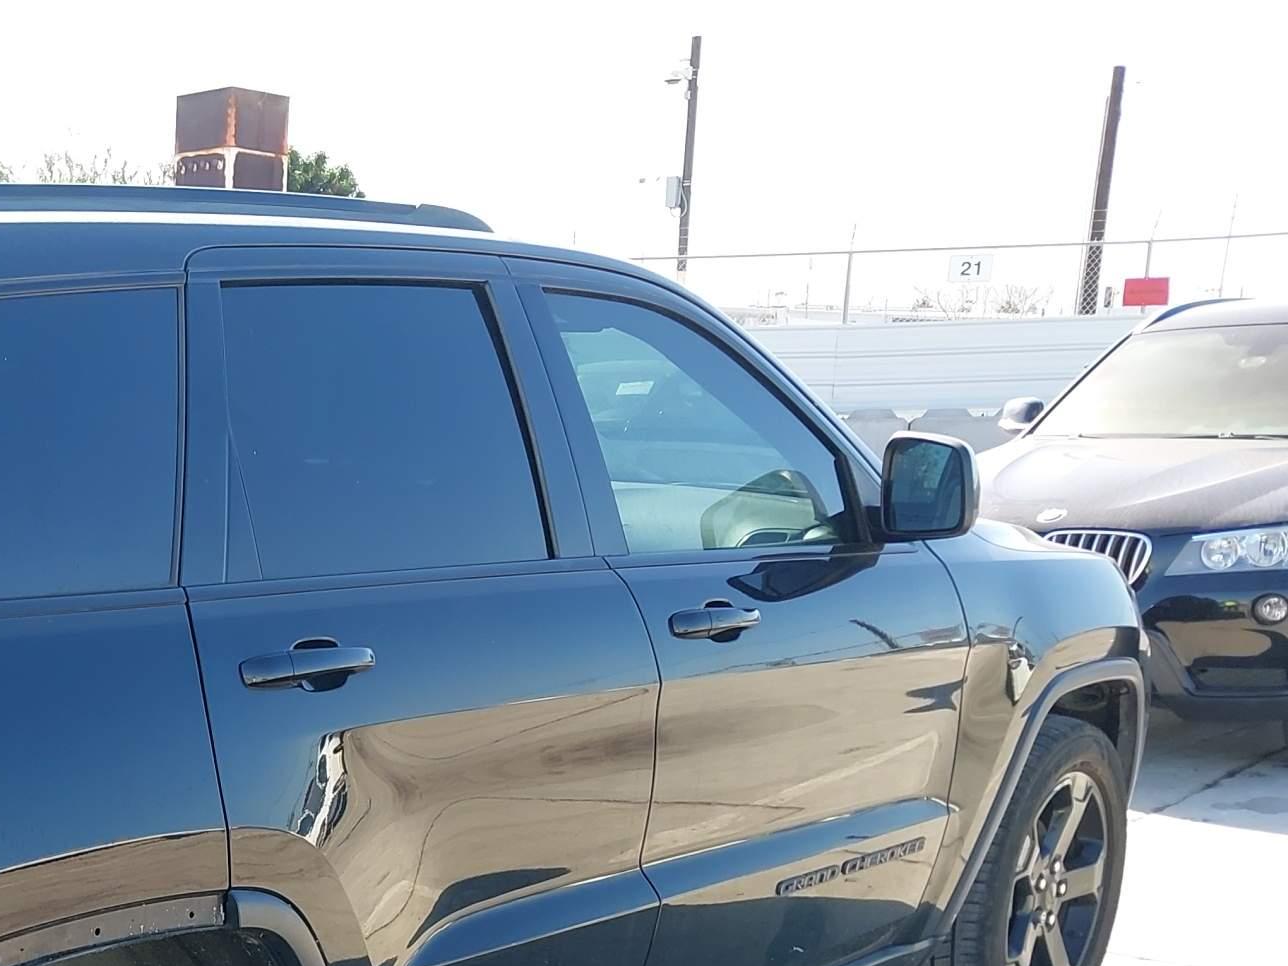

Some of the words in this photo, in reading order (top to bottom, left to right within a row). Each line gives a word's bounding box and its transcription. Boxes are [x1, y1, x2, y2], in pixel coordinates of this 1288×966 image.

[960, 261, 982, 276] 21
[777, 865, 840, 896] GRAND
[841, 836, 926, 875] CHEROKEE
